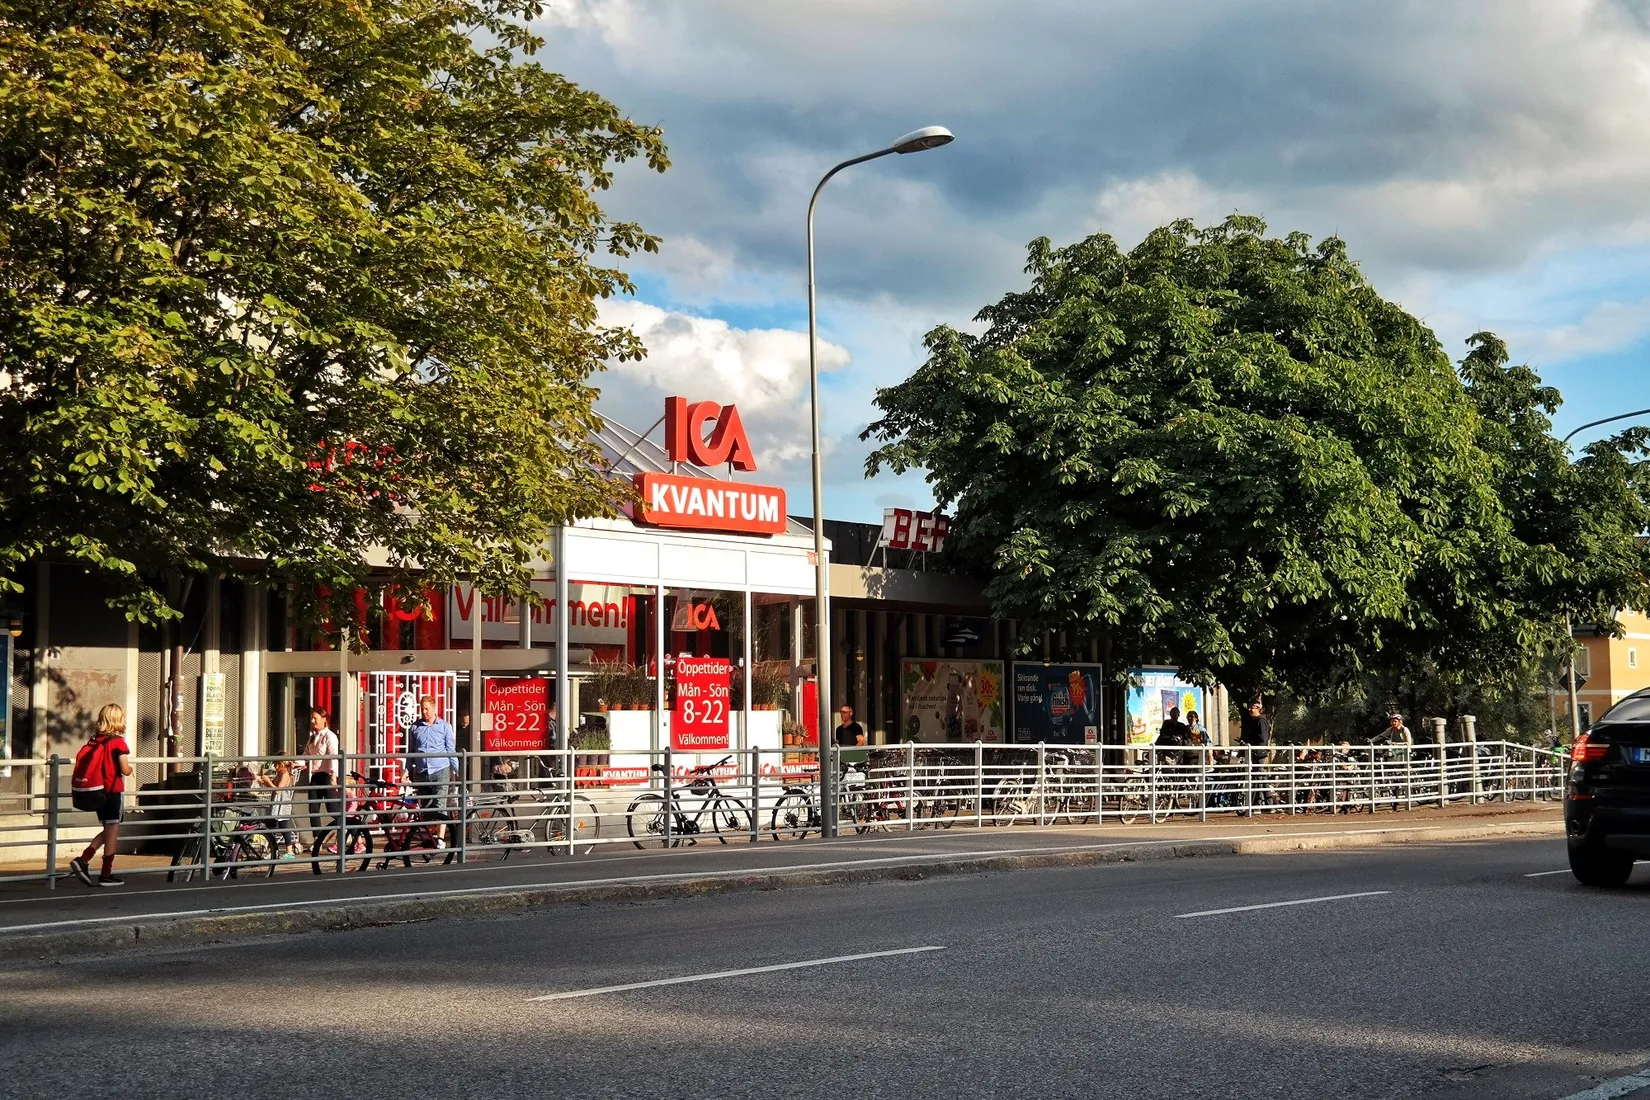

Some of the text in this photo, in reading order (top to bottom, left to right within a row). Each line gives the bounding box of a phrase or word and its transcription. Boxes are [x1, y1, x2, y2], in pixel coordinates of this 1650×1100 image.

[665, 396, 757, 472] ICA
[652, 482, 779, 523] KVANTUM
[687, 602, 721, 631] ICA
[678, 659, 728, 677] Öppettider
[1017, 673, 1039, 682] Skinande
[489, 682, 546, 696] Öppettider
[678, 682, 701, 697] Mån
[709, 683, 729, 697] Sön
[489, 700, 514, 711] Mån
[524, 700, 546, 711] Sön
[683, 699, 724, 724] 8-22
[494, 713, 540, 731] 8-22
[489, 738, 546, 747] Välkommen!
[678, 733, 729, 745] Välkommen!
